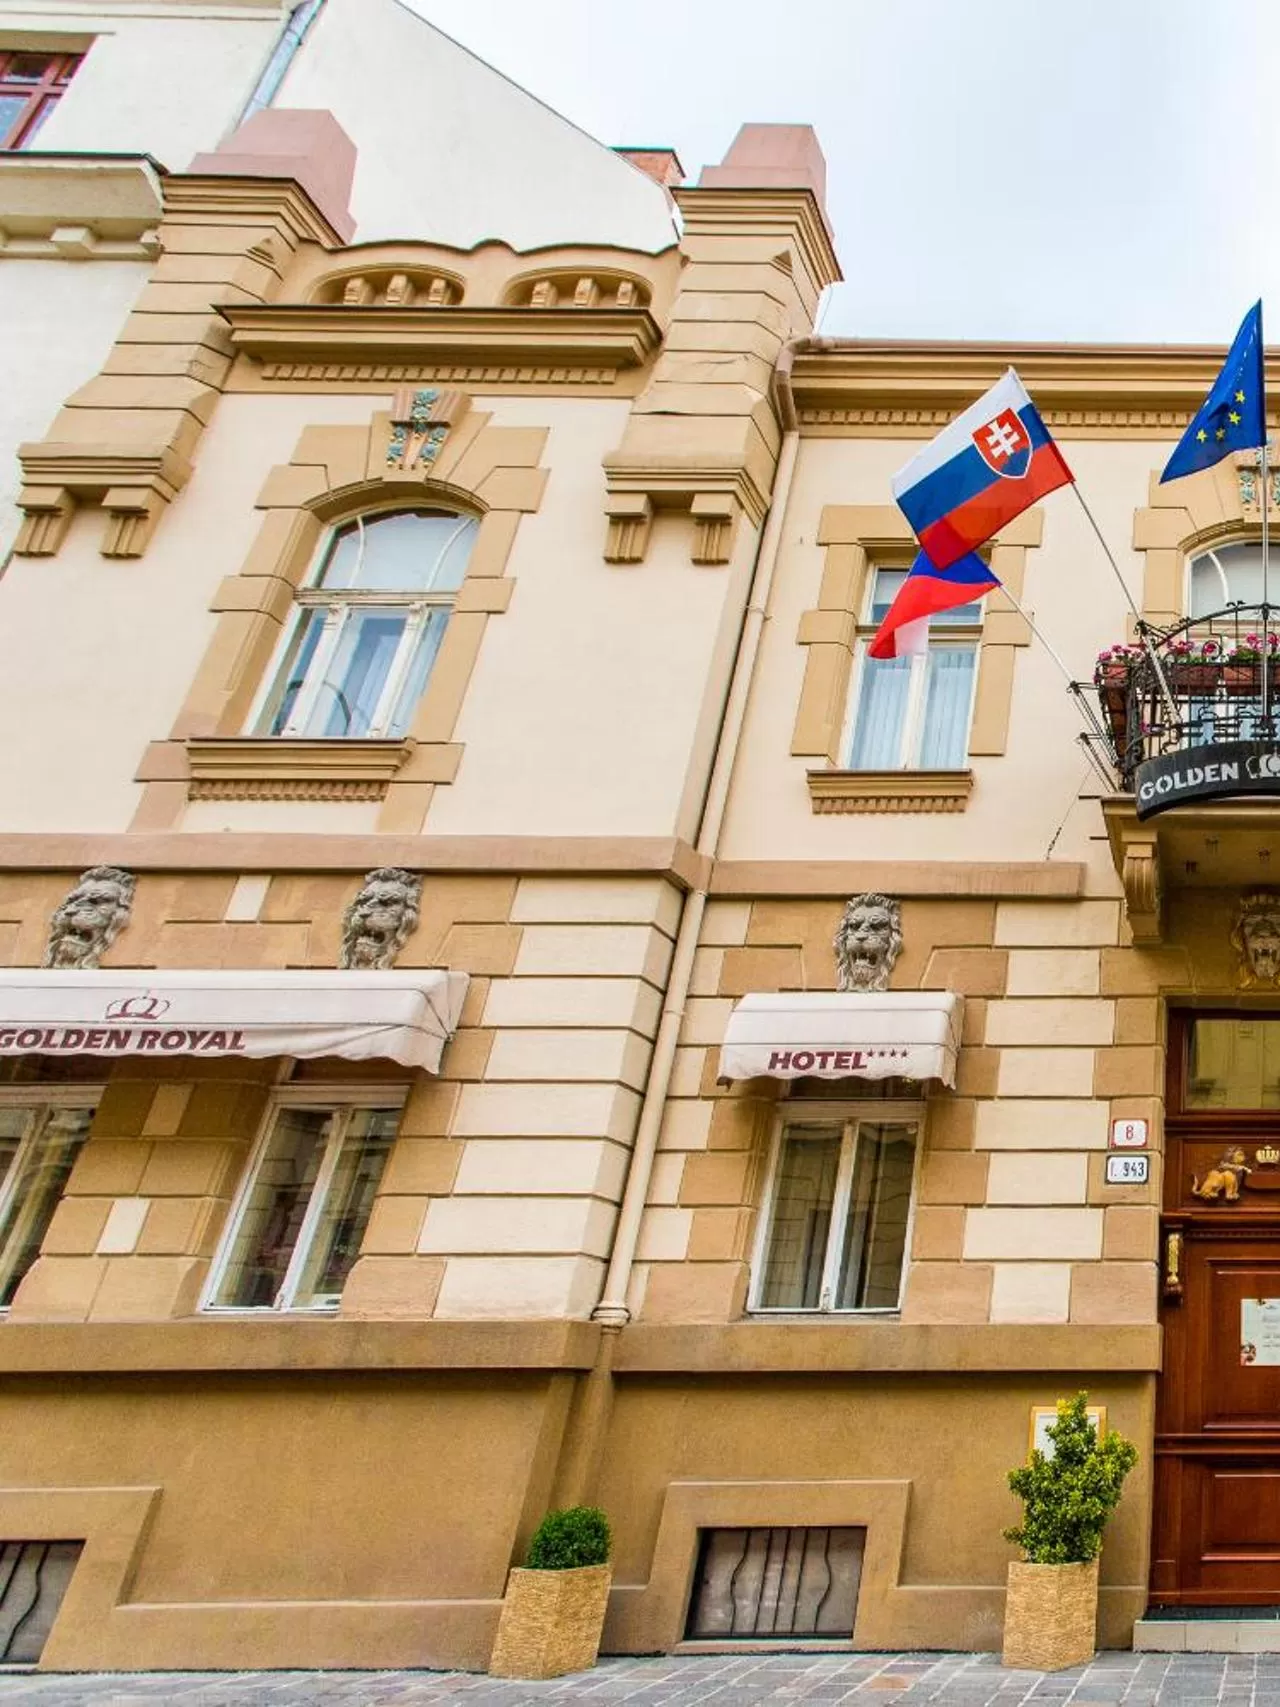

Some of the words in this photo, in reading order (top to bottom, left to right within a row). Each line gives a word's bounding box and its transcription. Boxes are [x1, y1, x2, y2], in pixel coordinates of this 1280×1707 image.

[1139, 761, 1239, 800] GOLDEN
[0, 1028, 132, 1050] GOLDEN
[136, 1029, 246, 1050] ROYAL
[768, 1051, 868, 1071] HOTEL
[1122, 1161, 1145, 1177] 943
